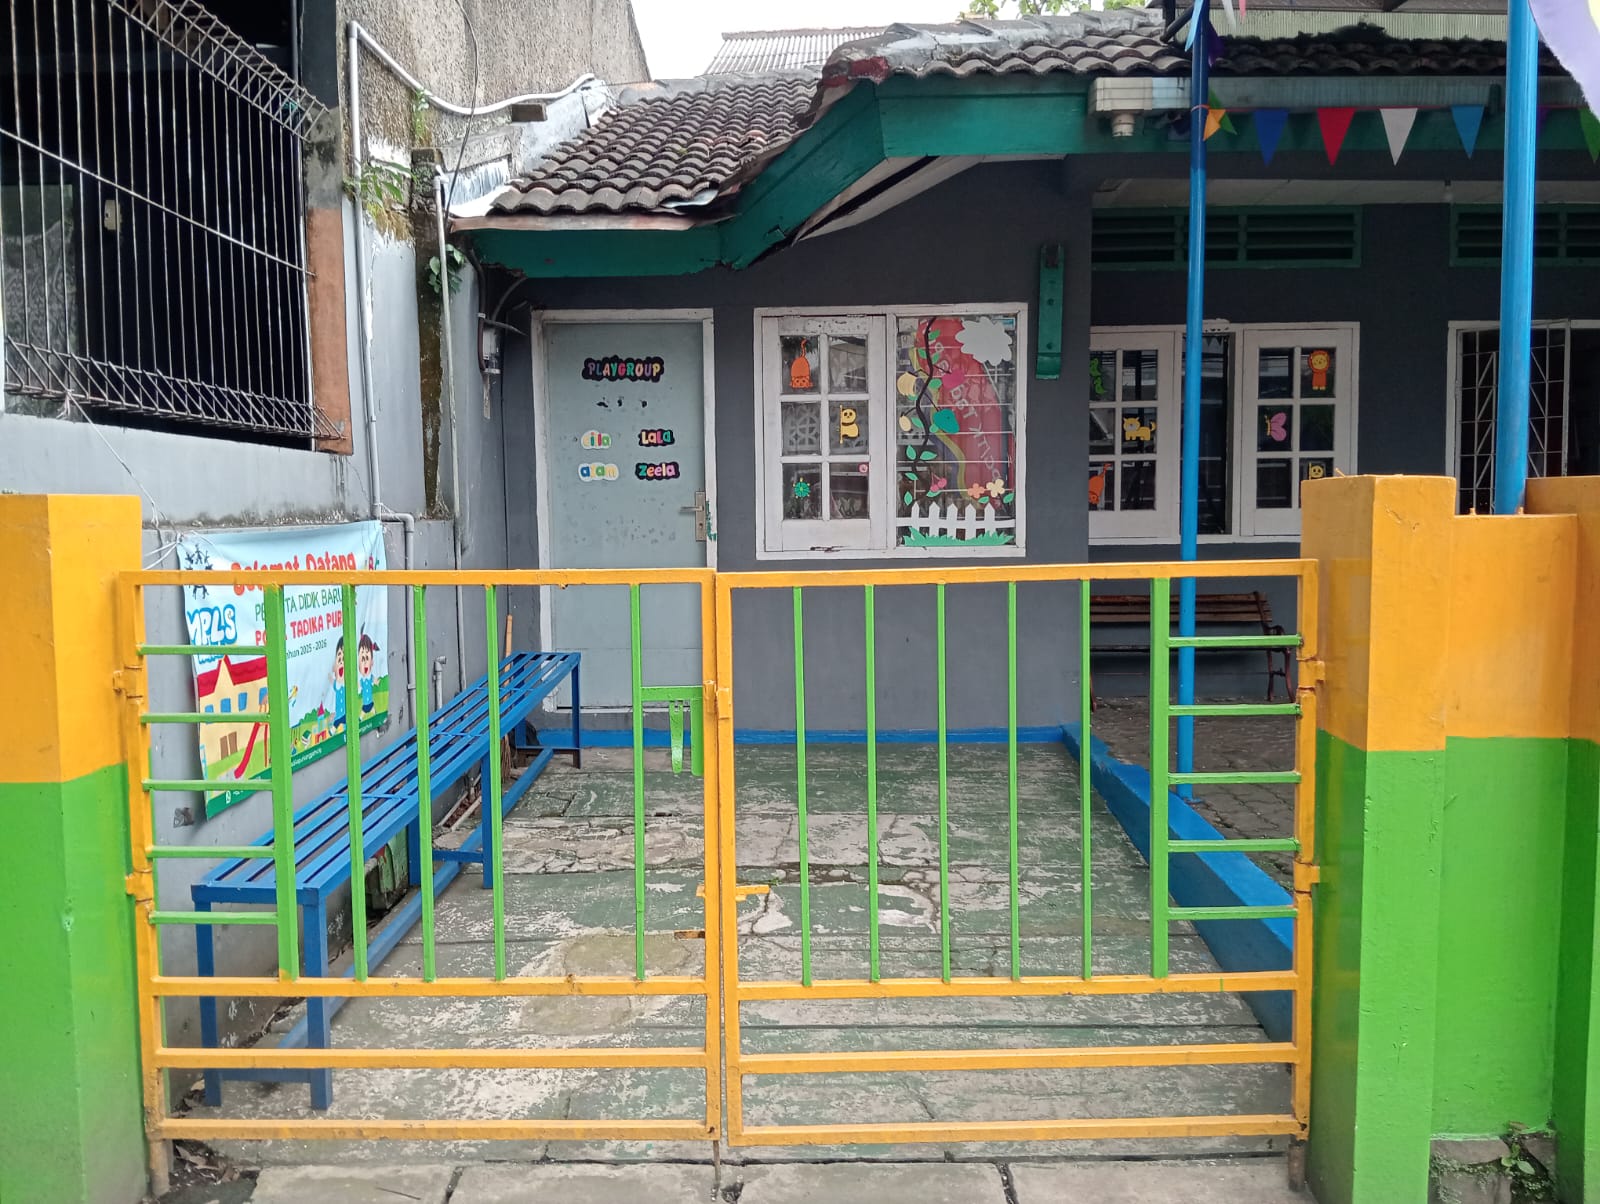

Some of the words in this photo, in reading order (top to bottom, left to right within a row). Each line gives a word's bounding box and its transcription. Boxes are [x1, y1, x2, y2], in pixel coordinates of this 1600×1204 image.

[587, 362, 661, 377] PLAYGROUP
[298, 591, 320, 612] DIDIK
[290, 614, 324, 640] TADIKA
[300, 642, 312, 656] 2025
[315, 638, 327, 651] 2026
